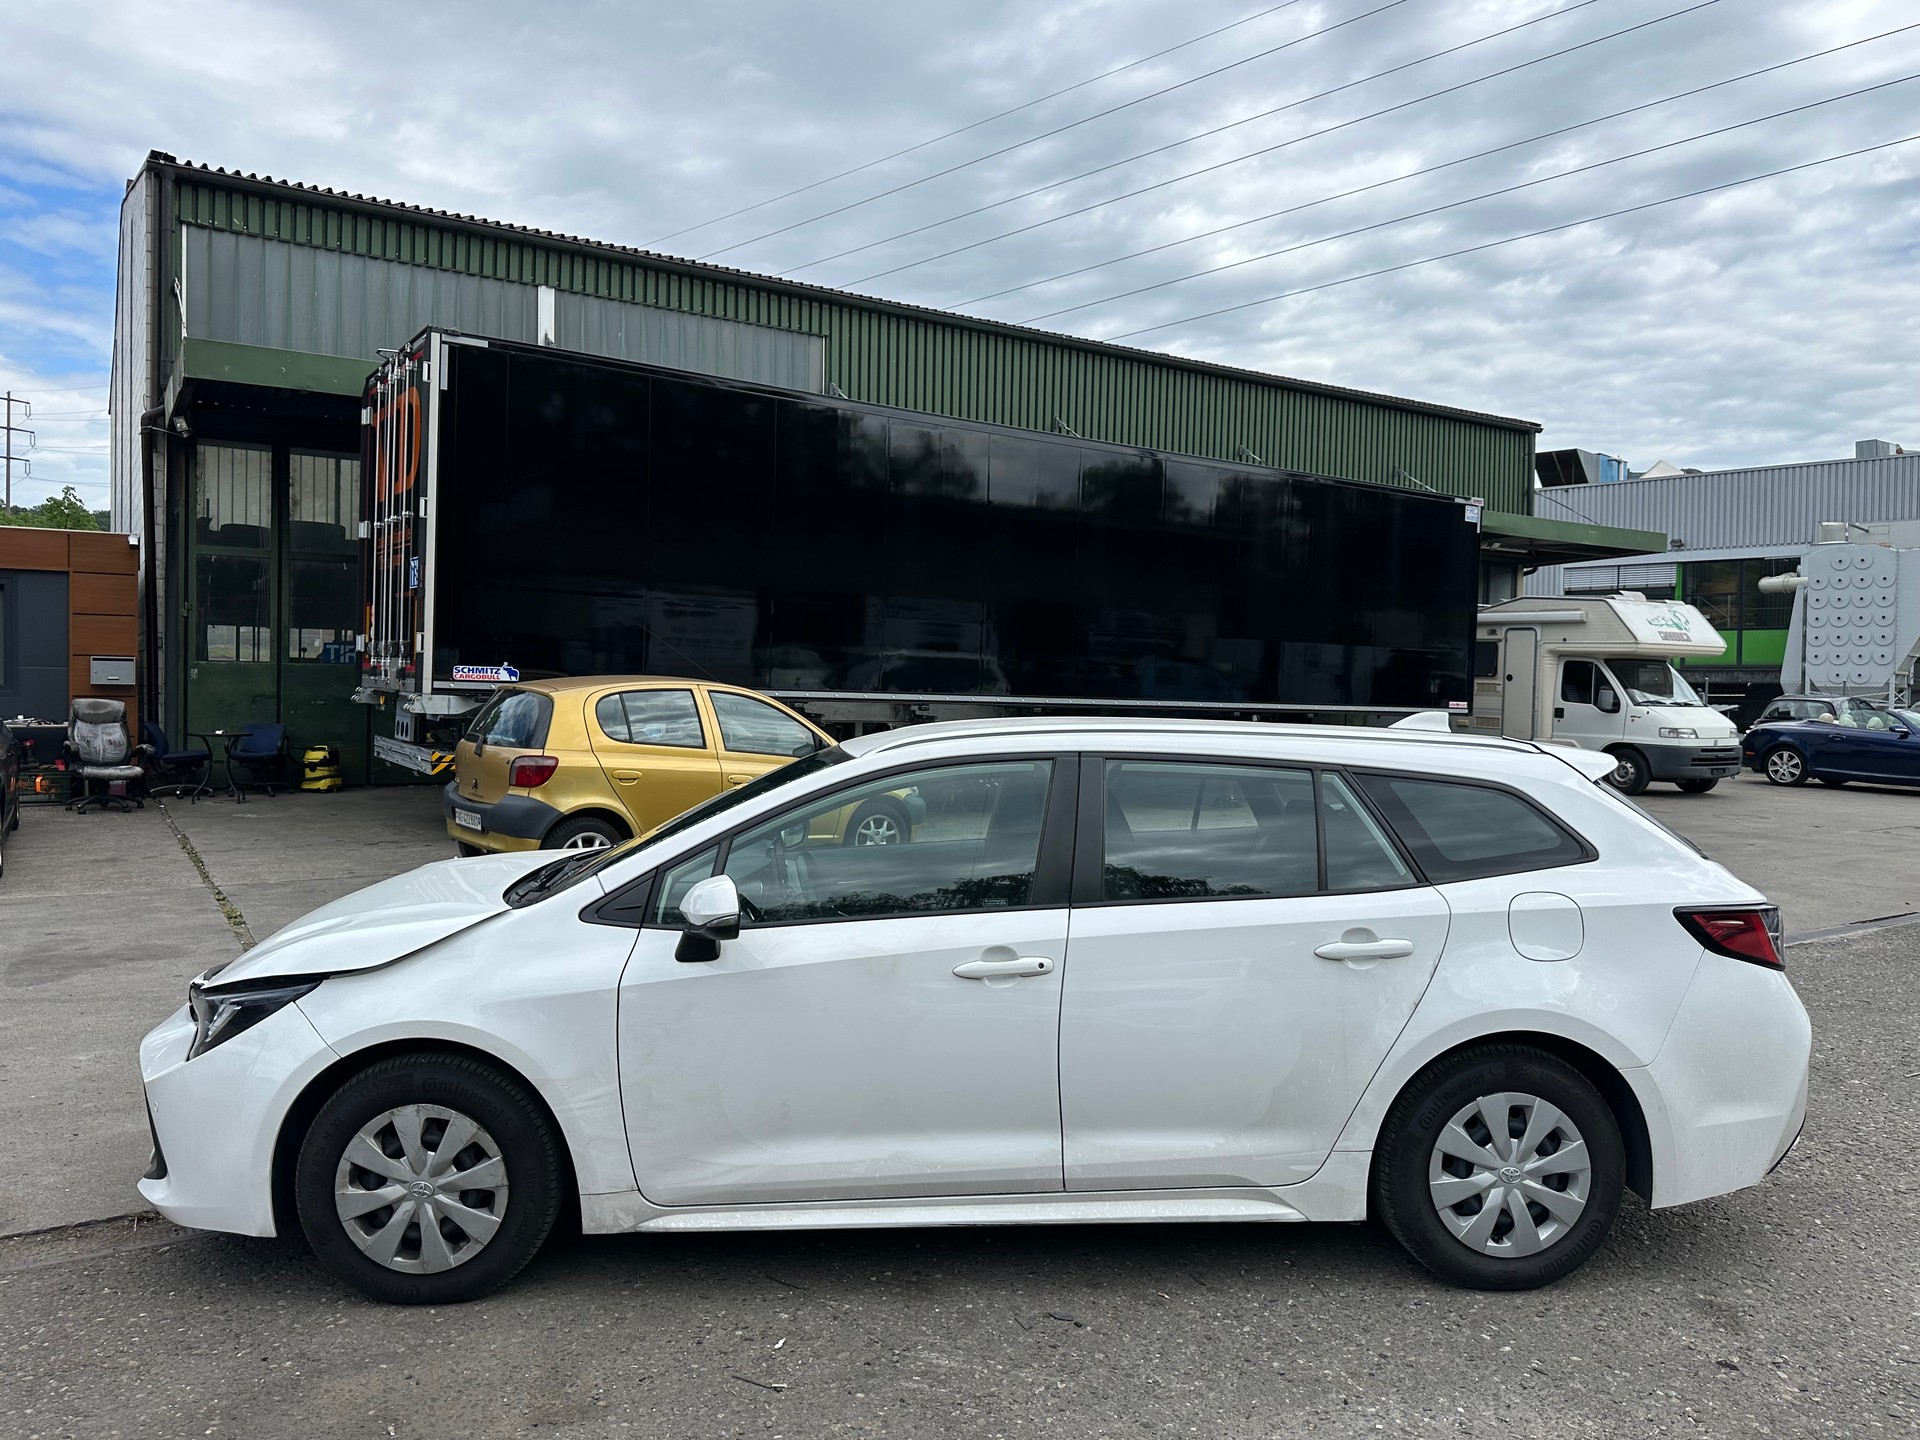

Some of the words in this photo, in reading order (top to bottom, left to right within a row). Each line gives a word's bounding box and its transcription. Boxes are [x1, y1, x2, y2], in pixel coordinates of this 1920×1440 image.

[454, 666, 501, 675] SCHMITZ
[422, 1077, 505, 1119] Continental
[1419, 1071, 1485, 1130] Continental
[1537, 1218, 1604, 1276] Continental
